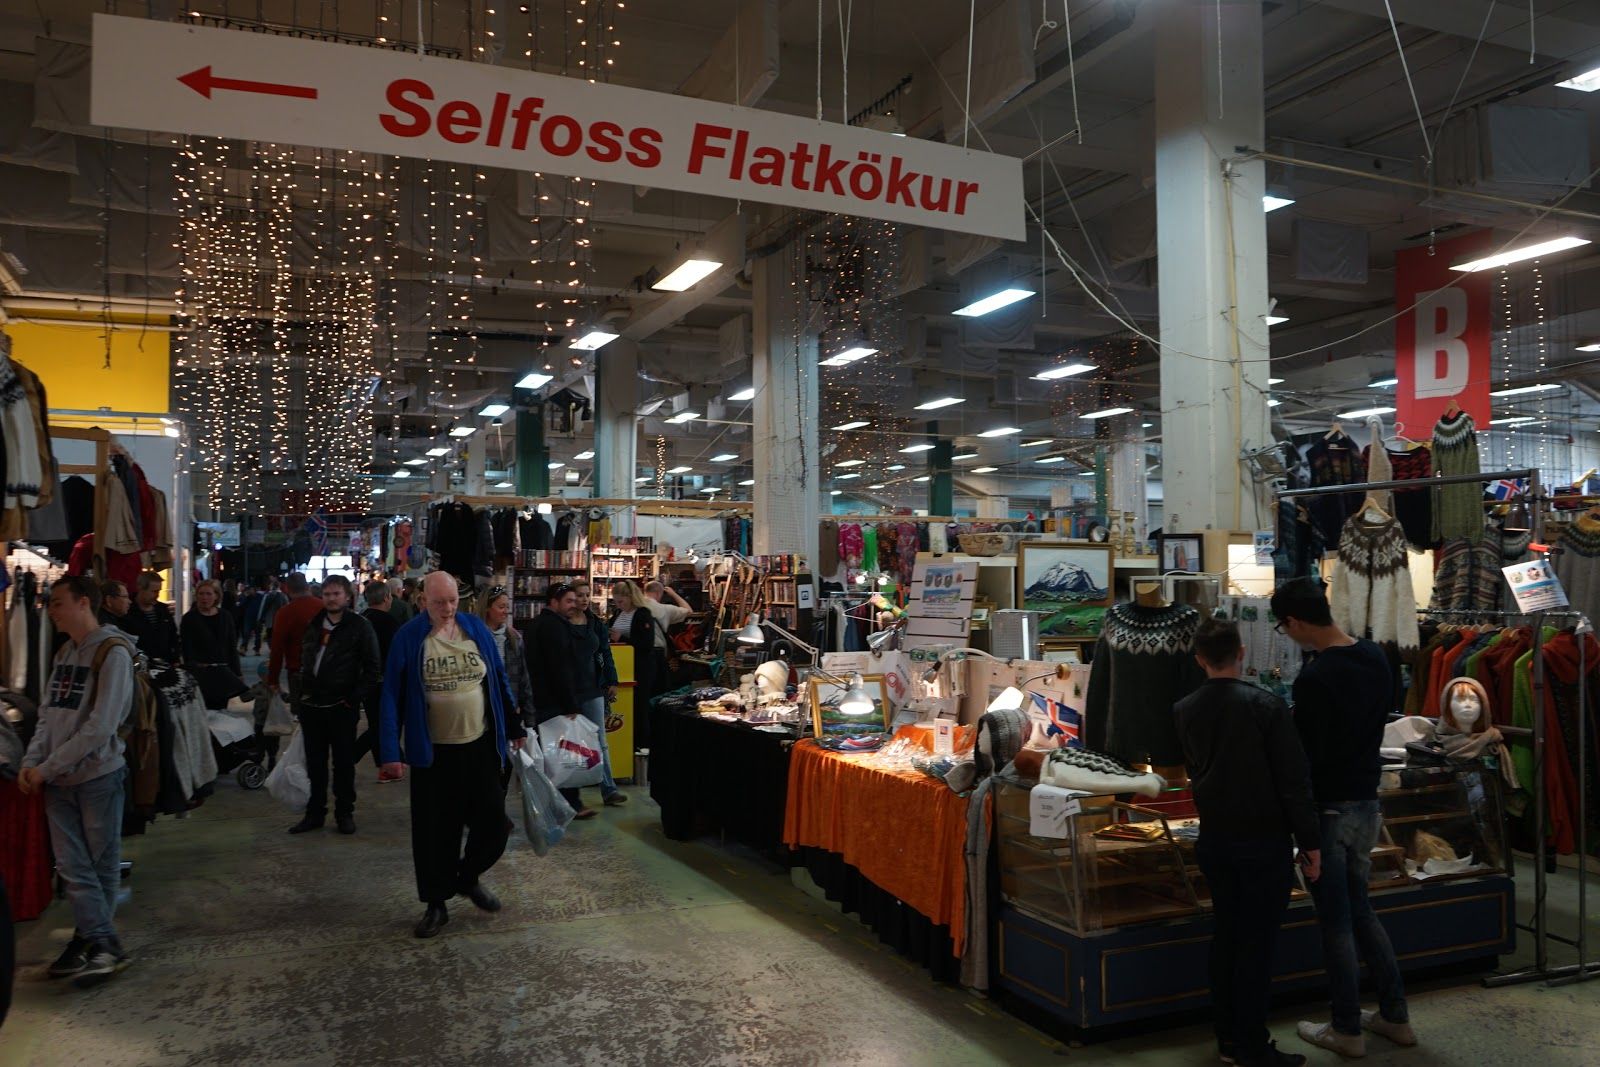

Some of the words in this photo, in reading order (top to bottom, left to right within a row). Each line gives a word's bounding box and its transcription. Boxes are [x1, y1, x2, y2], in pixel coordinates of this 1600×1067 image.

[378, 78, 663, 169] Selfoss
[687, 122, 978, 215] Flatkökur
[1414, 286, 1470, 400] B
